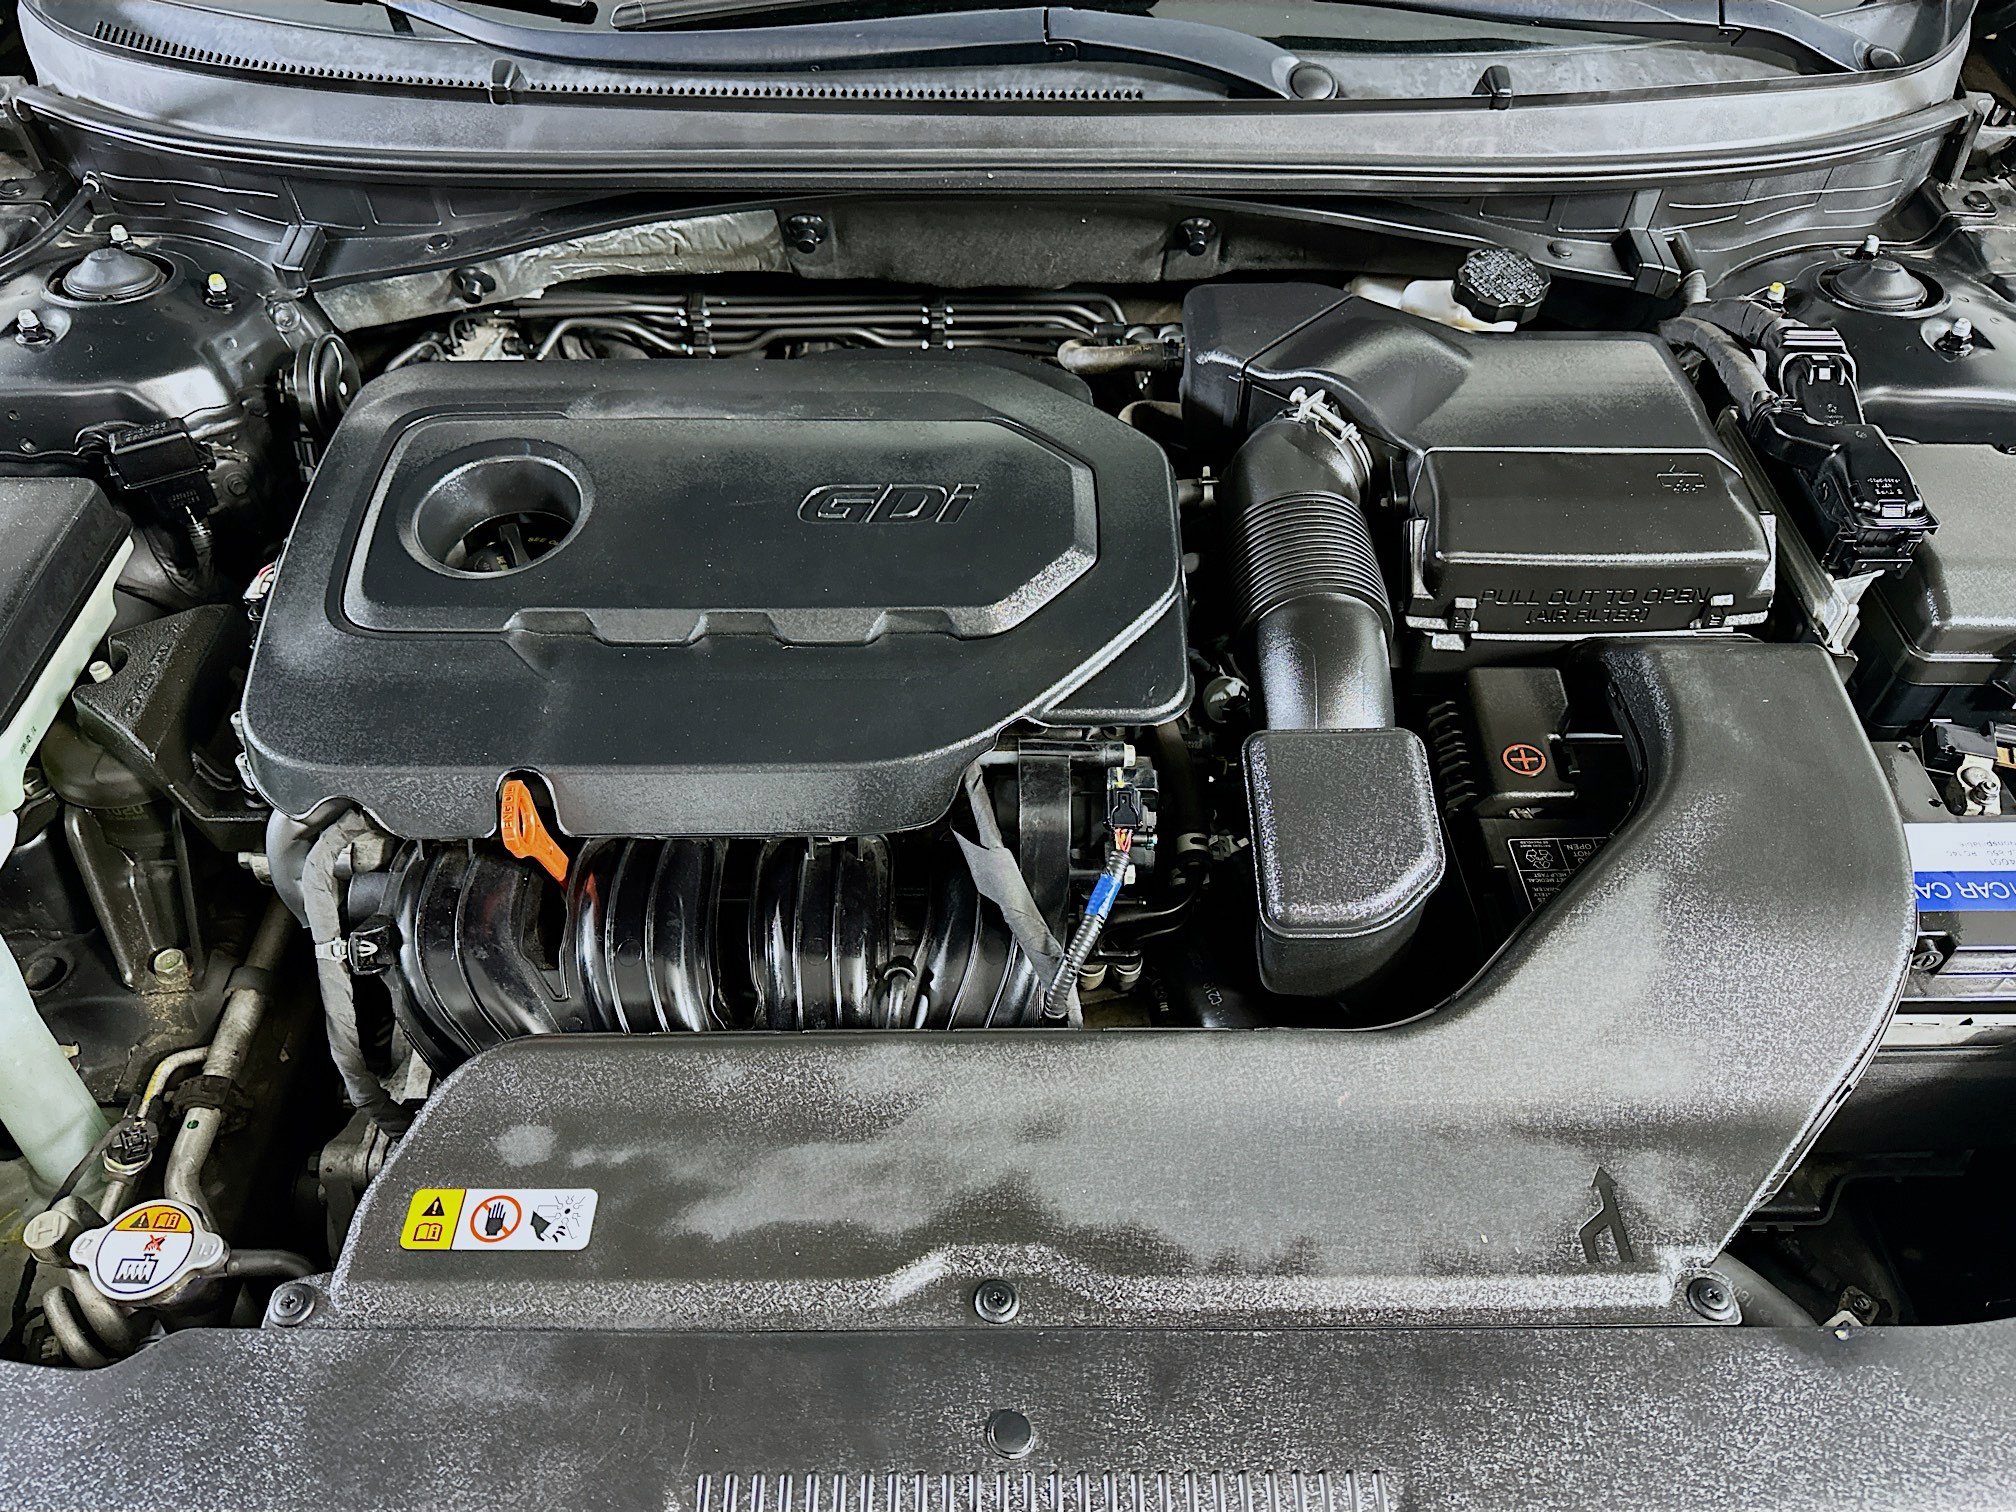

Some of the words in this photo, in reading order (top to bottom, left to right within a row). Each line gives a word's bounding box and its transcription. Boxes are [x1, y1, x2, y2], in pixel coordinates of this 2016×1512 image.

[797, 483, 979, 524] GDi
[1480, 588, 1540, 605] PULL
[1547, 588, 1599, 605] OUT
[1605, 587, 1637, 605] TO
[1641, 586, 1710, 605] OPEN
[503, 786, 514, 803] OIL
[503, 804, 514, 830] ENG
